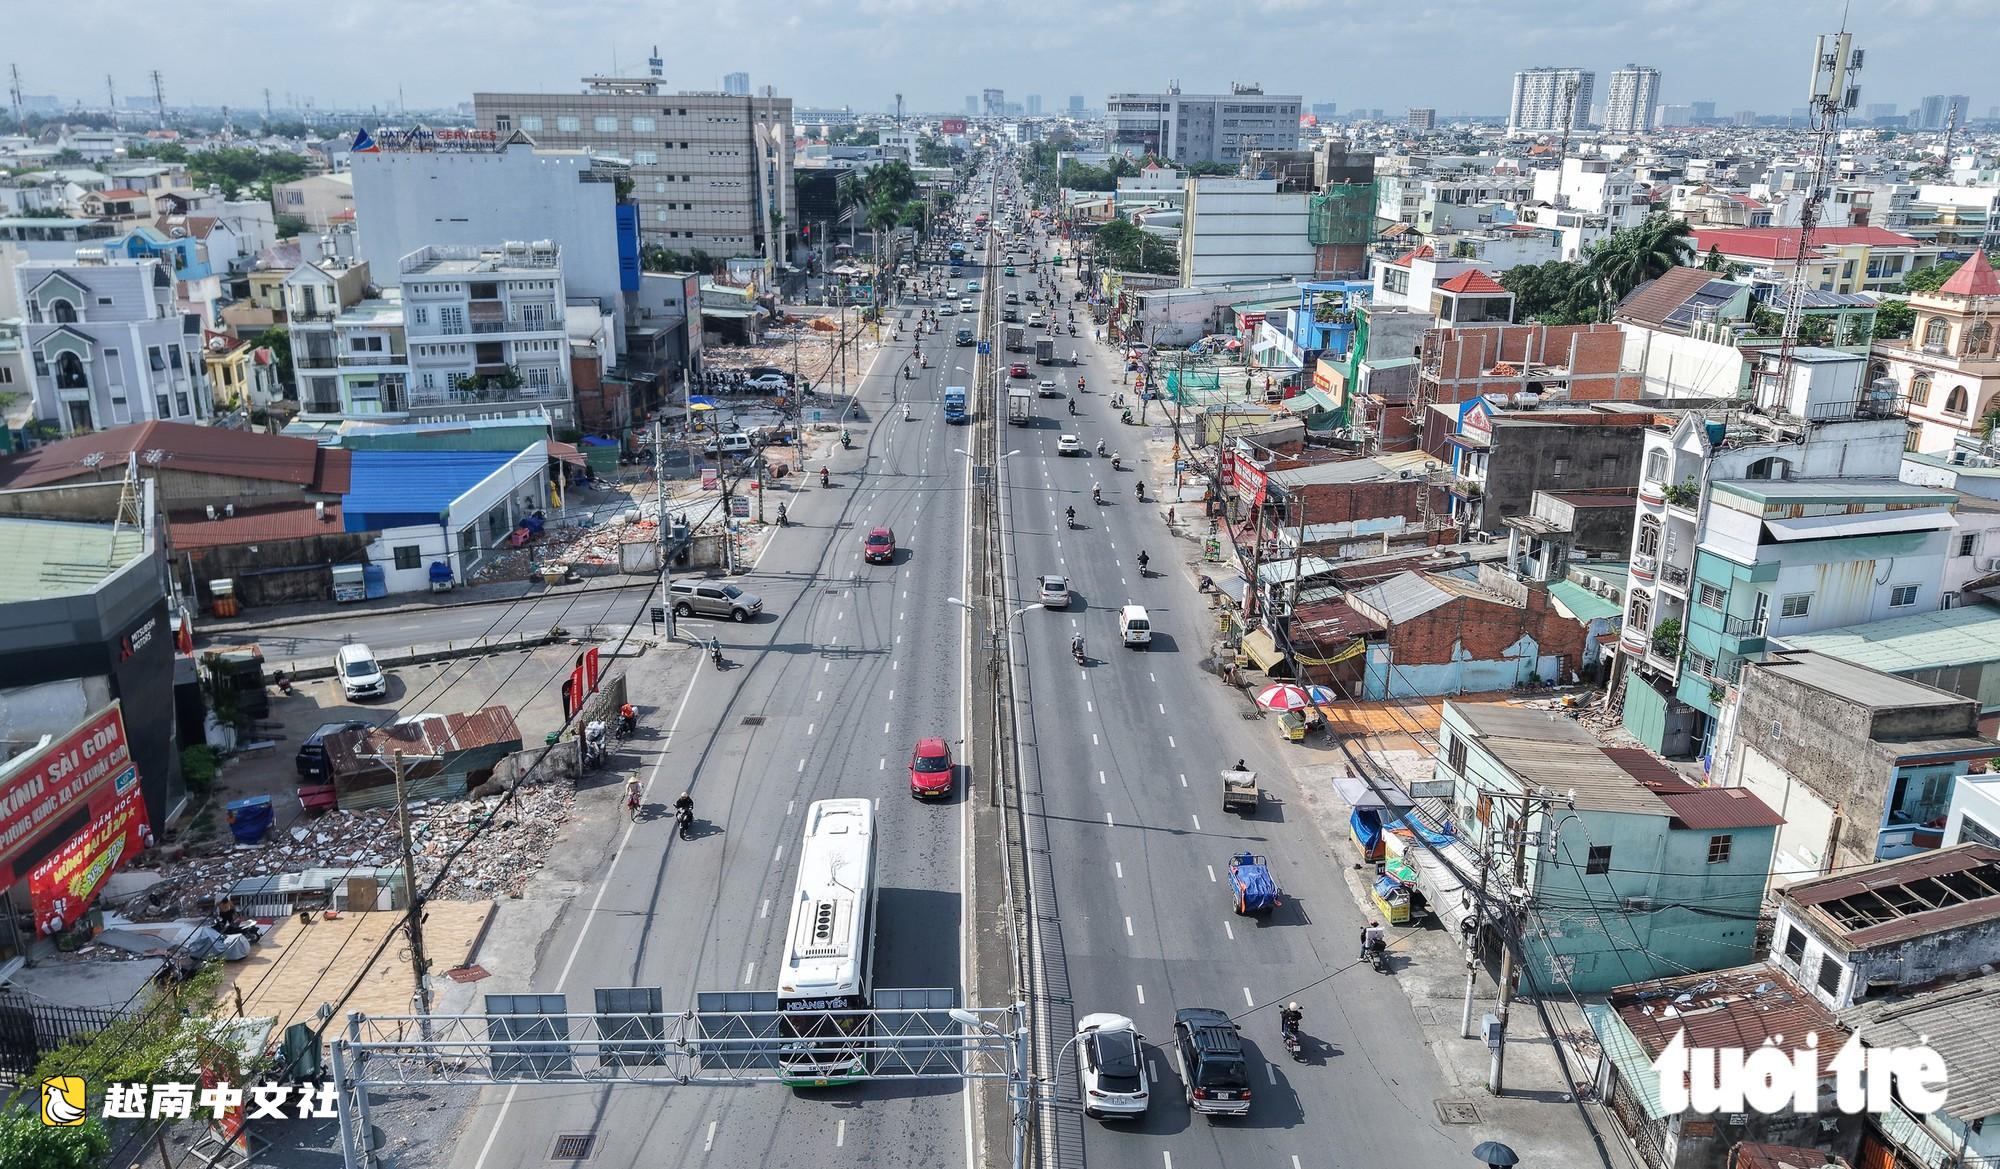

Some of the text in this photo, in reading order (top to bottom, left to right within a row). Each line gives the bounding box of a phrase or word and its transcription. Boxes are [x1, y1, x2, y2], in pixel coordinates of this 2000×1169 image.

[437, 130, 497, 141] SERVICES
[131, 617, 156, 643] MITSUBISHI
[132, 631, 152, 653] MOTORS
[0, 722, 118, 822] KÍNH SÀI GÒN
[32, 795, 58, 824] KHÚC
[58, 785, 73, 806] XẠ
[82, 757, 109, 785] THUẬT
[33, 854, 60, 880] CHÀO
[63, 829, 89, 856] MỪNG
[92, 811, 111, 832] NĂM
[114, 795, 132, 814] HỌC
[786, 996, 848, 1010] HOÀNG YẾN
